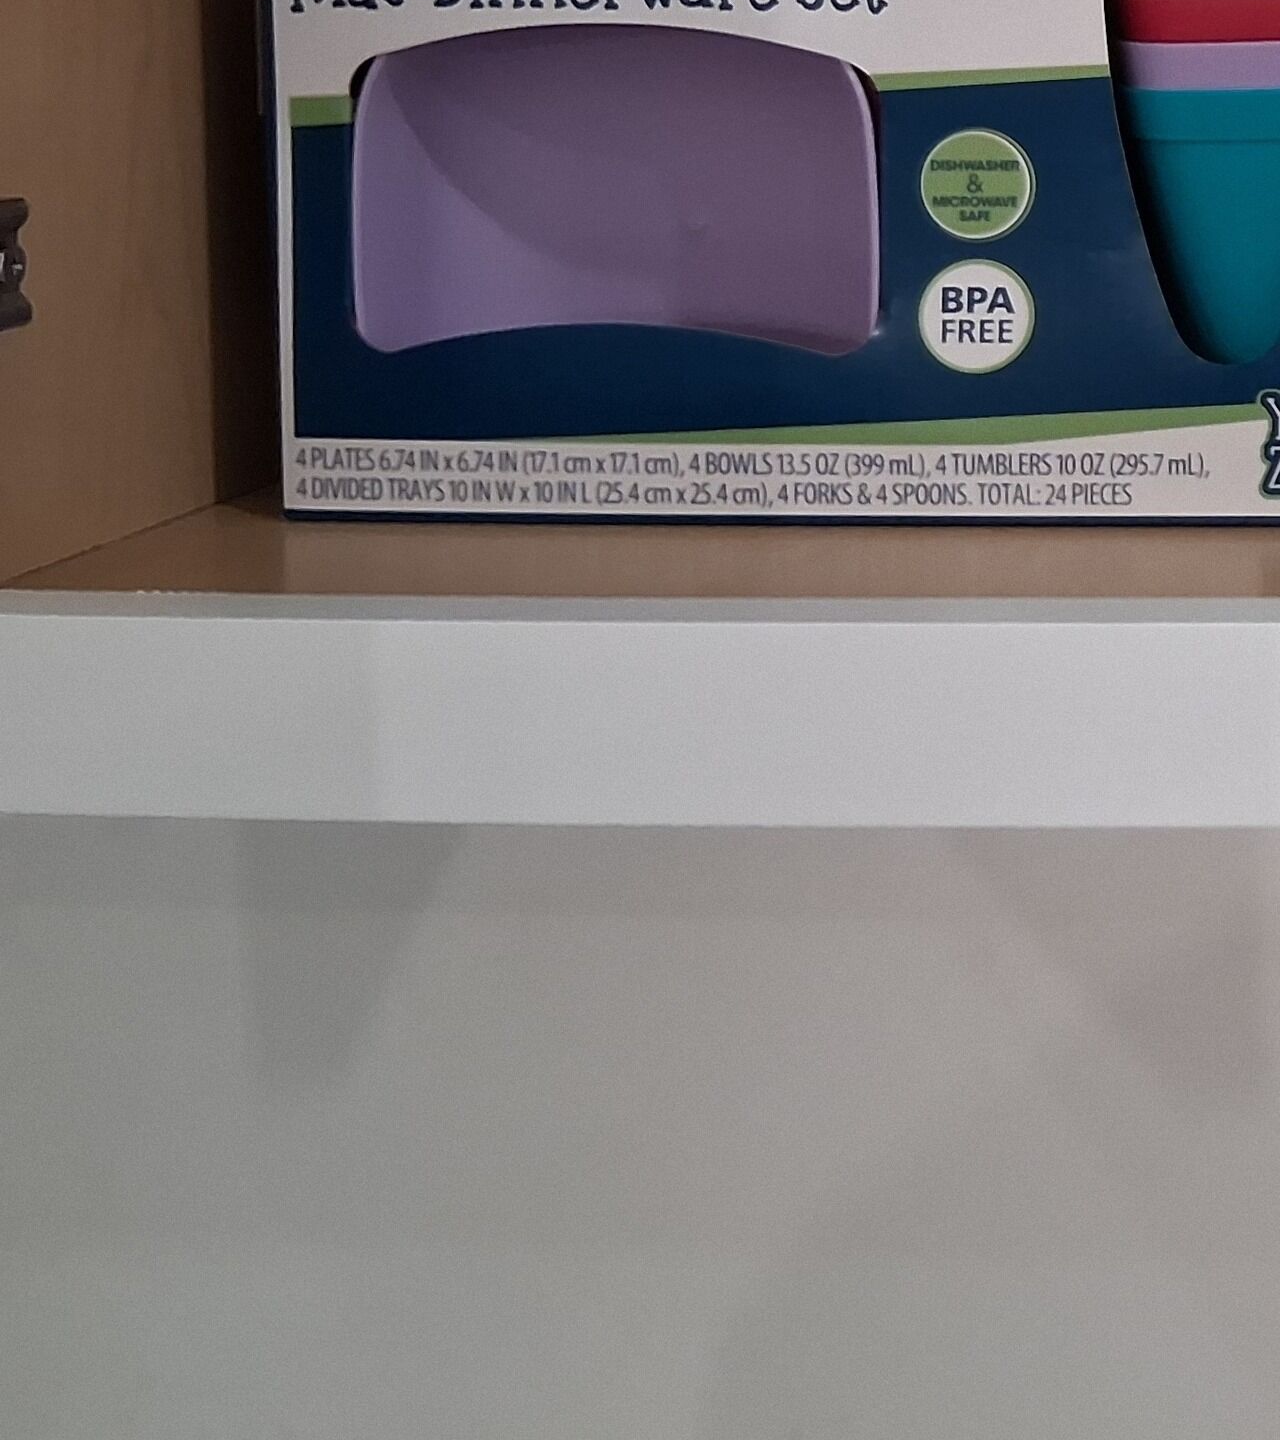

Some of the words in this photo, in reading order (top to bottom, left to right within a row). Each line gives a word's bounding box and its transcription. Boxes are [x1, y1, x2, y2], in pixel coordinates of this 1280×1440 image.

[930, 160, 1020, 172] DISHWASHER
[966, 174, 983, 193] &
[932, 196, 1018, 208] MICROWAVE
[959, 210, 990, 222] SAFE
[940, 286, 1015, 314] BPA
[941, 319, 1013, 343] FREE
[296, 448, 307, 468] 4
[311, 447, 374, 471] PLATES
[421, 449, 440, 471] IN
[499, 451, 517, 472] IN
[564, 456, 591, 474] cm
[689, 453, 701, 474] 4
[706, 452, 773, 475] BOWLS
[778, 453, 811, 476] 13.5
[816, 453, 840, 475] OZ
[844, 453, 885, 479] (399
[935, 454, 947, 475] 4
[951, 453, 1052, 475] TUMBLERS
[1057, 453, 1077, 475] 10
[1081, 453, 1105, 475] OZ
[296, 478, 306, 497] 4
[311, 477, 384, 500] DIVIDED
[388, 478, 446, 501] TRAYS
[449, 479, 469, 501] 10
[472, 479, 491, 501] IN
[494, 480, 516, 502] W
[533, 480, 553, 503] 10
[557, 481, 577, 503] IN
[581, 481, 592, 503] L
[644, 486, 671, 503] cm
[690, 482, 728, 504] 25.4
[777, 483, 789, 504] 4
[793, 482, 853, 505] FORKS
[857, 483, 872, 504] &
[875, 483, 888, 504] 4
[1045, 483, 1067, 505] 24
[1071, 482, 1133, 505] PIECES
